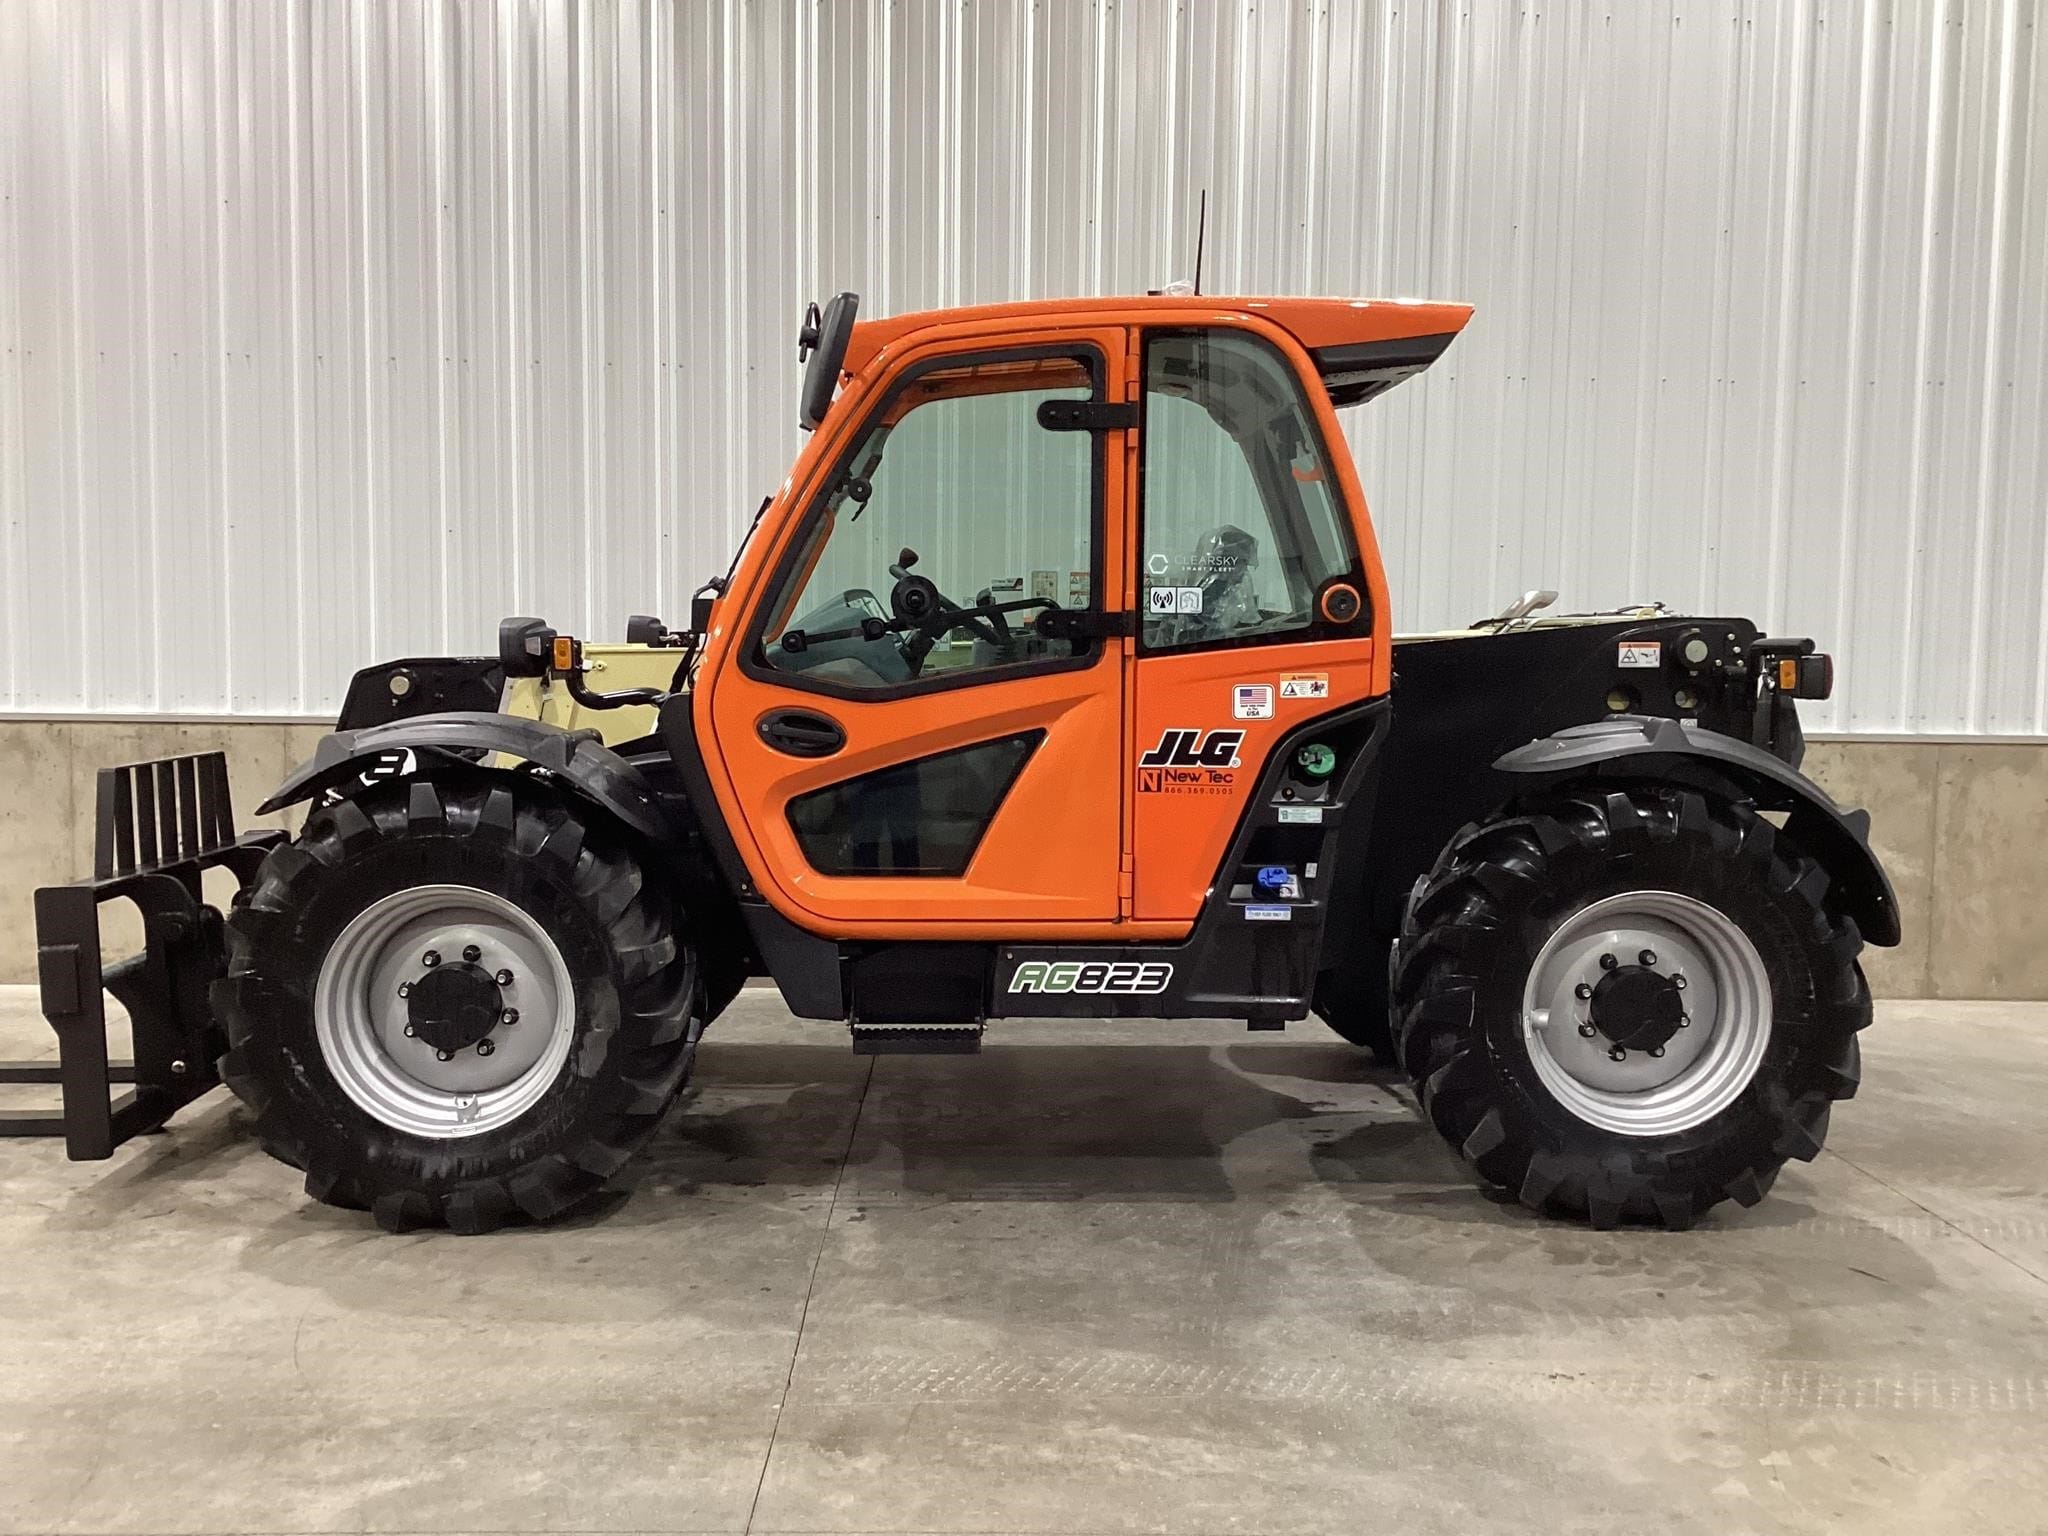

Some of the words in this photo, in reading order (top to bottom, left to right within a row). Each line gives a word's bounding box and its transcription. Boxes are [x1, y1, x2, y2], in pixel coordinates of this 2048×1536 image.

[1174, 555, 1239, 566] CLEARSKY
[1139, 729, 1246, 768] JLG
[1164, 769, 1202, 783] New
[1205, 769, 1234, 784] Tec
[1008, 962, 1173, 994] AG823
